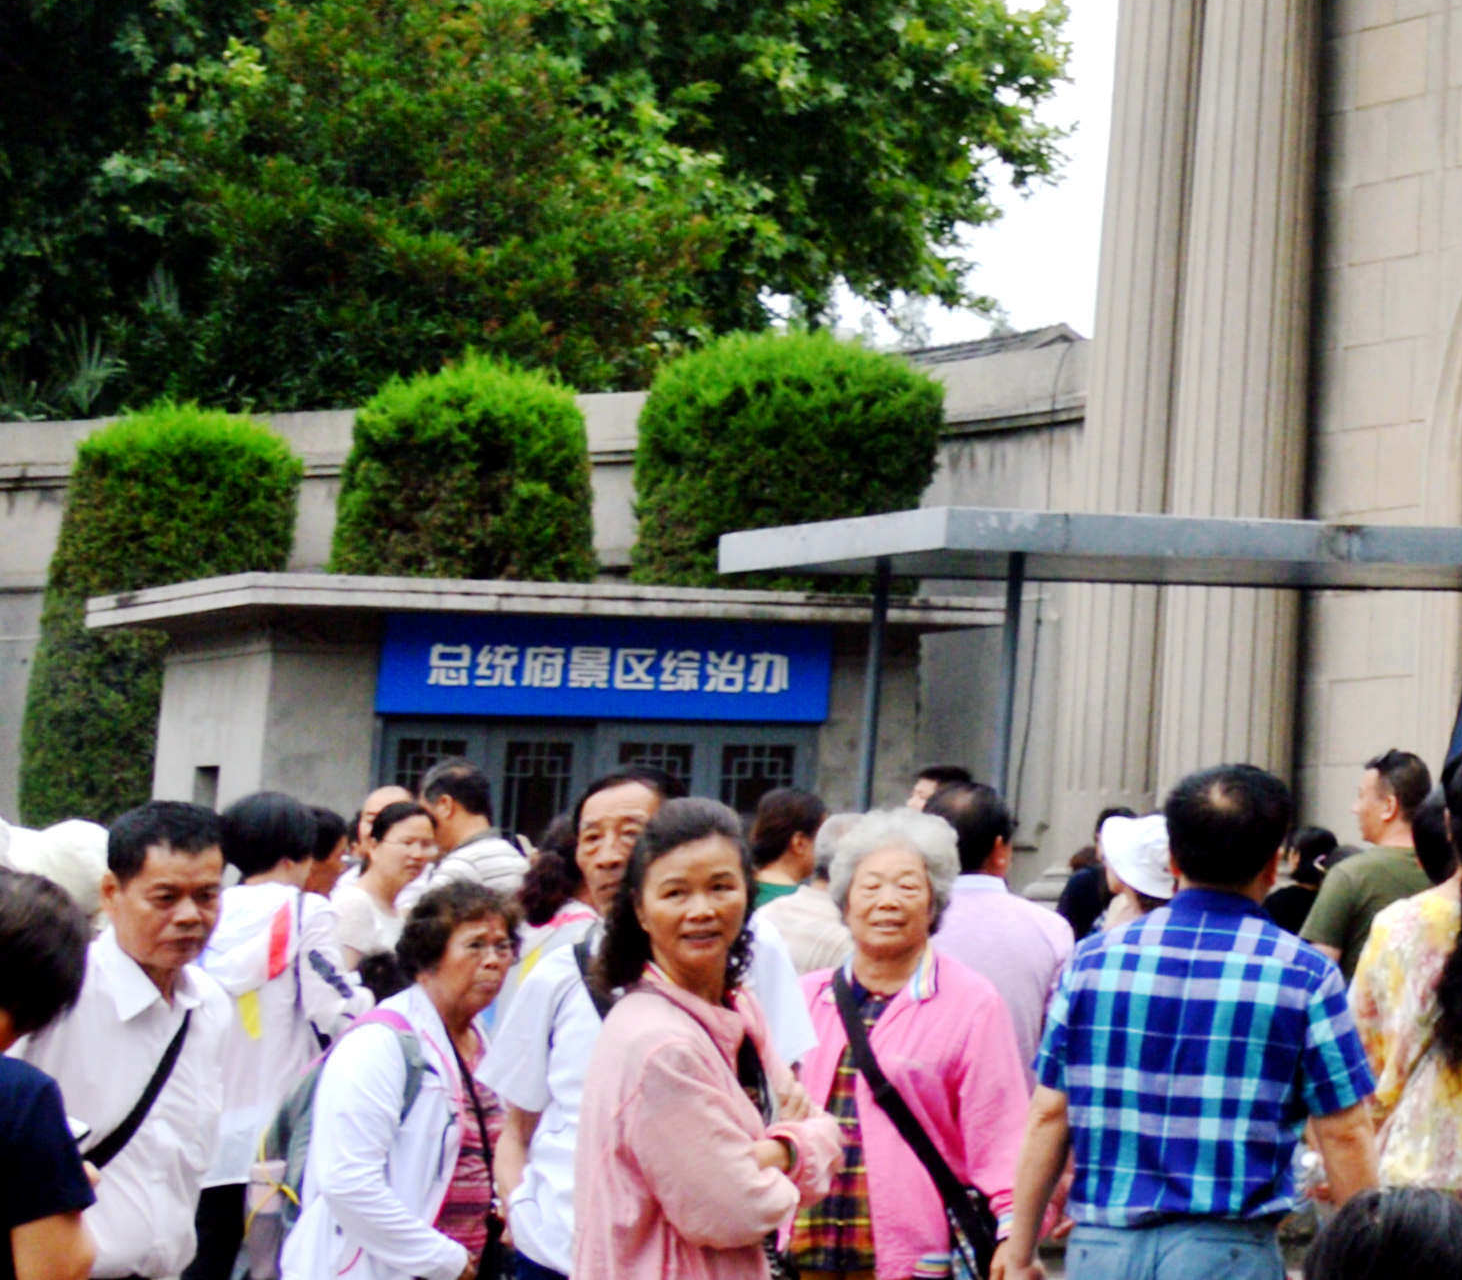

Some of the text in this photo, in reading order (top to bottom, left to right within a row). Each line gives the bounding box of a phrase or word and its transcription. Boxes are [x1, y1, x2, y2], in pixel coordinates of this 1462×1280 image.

[426, 643, 790, 695] 总统府景区综治办
